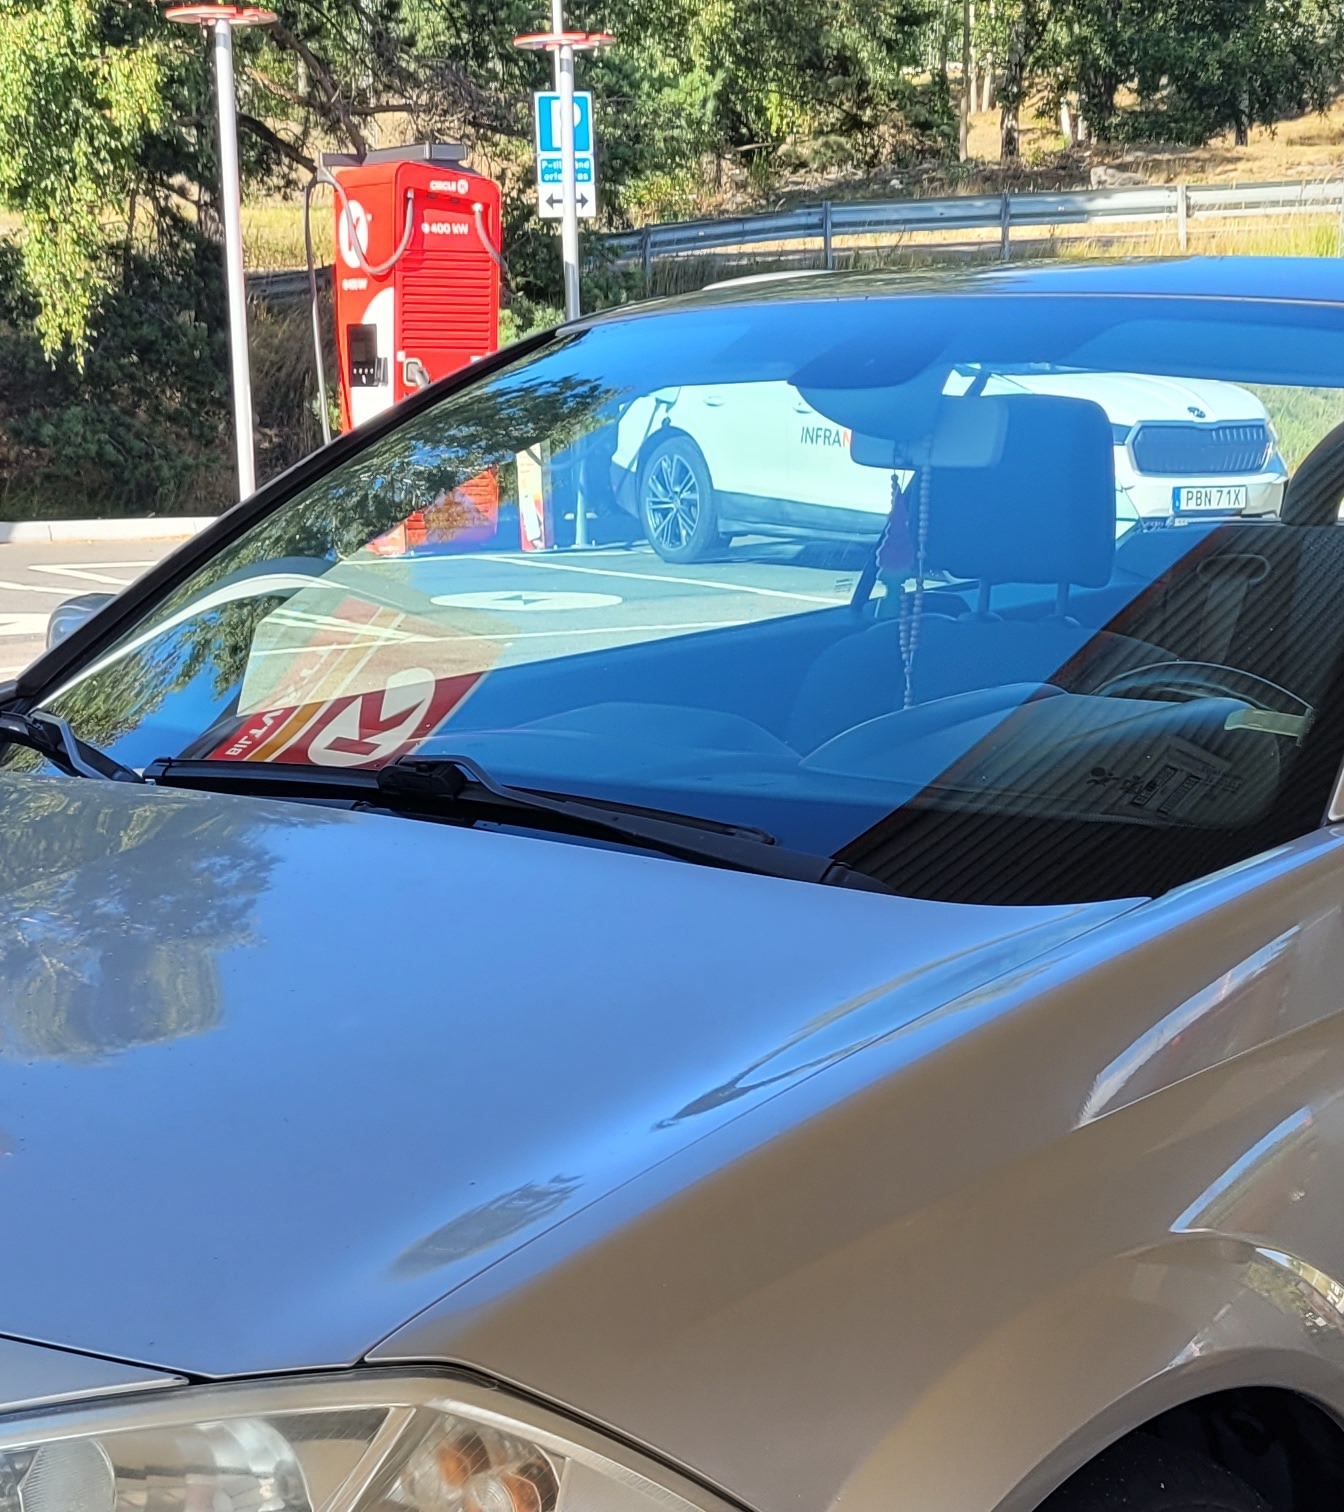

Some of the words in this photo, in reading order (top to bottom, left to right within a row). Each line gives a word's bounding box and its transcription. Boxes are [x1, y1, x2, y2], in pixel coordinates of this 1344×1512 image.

[431, 223, 451, 234] 400
[1186, 489, 1212, 507] PBN
[1216, 489, 1241, 506] 71X
